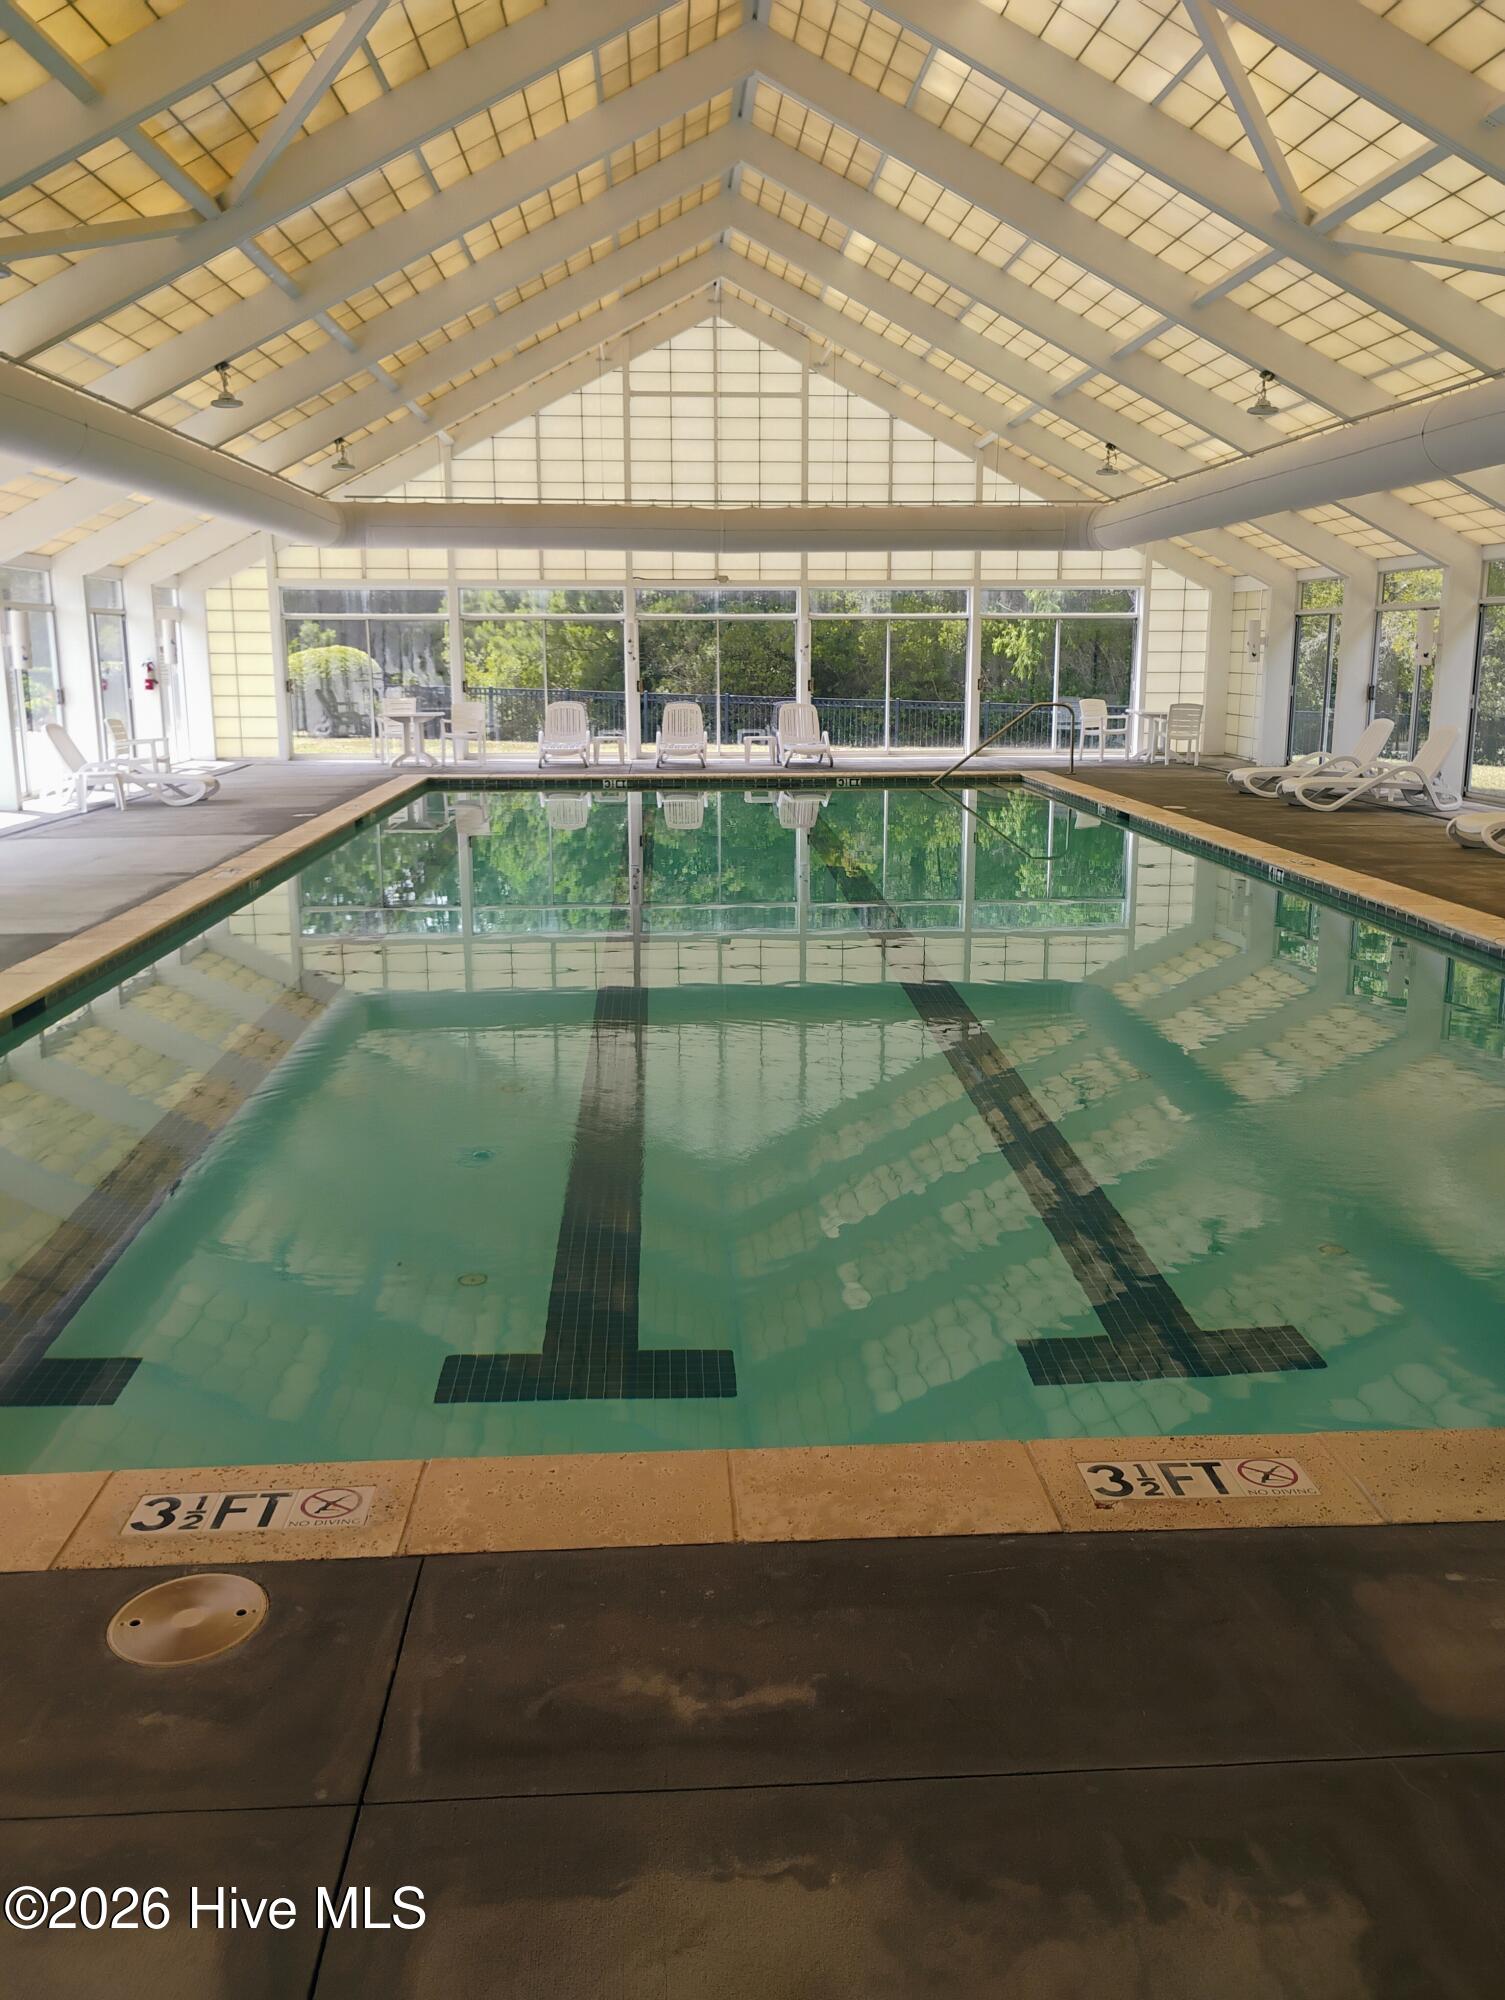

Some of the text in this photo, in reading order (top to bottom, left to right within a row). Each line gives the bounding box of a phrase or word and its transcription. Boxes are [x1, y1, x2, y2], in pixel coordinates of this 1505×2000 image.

[1271, 1487, 1318, 1495] DIVING
[288, 1518, 361, 1528] NO DIVING
